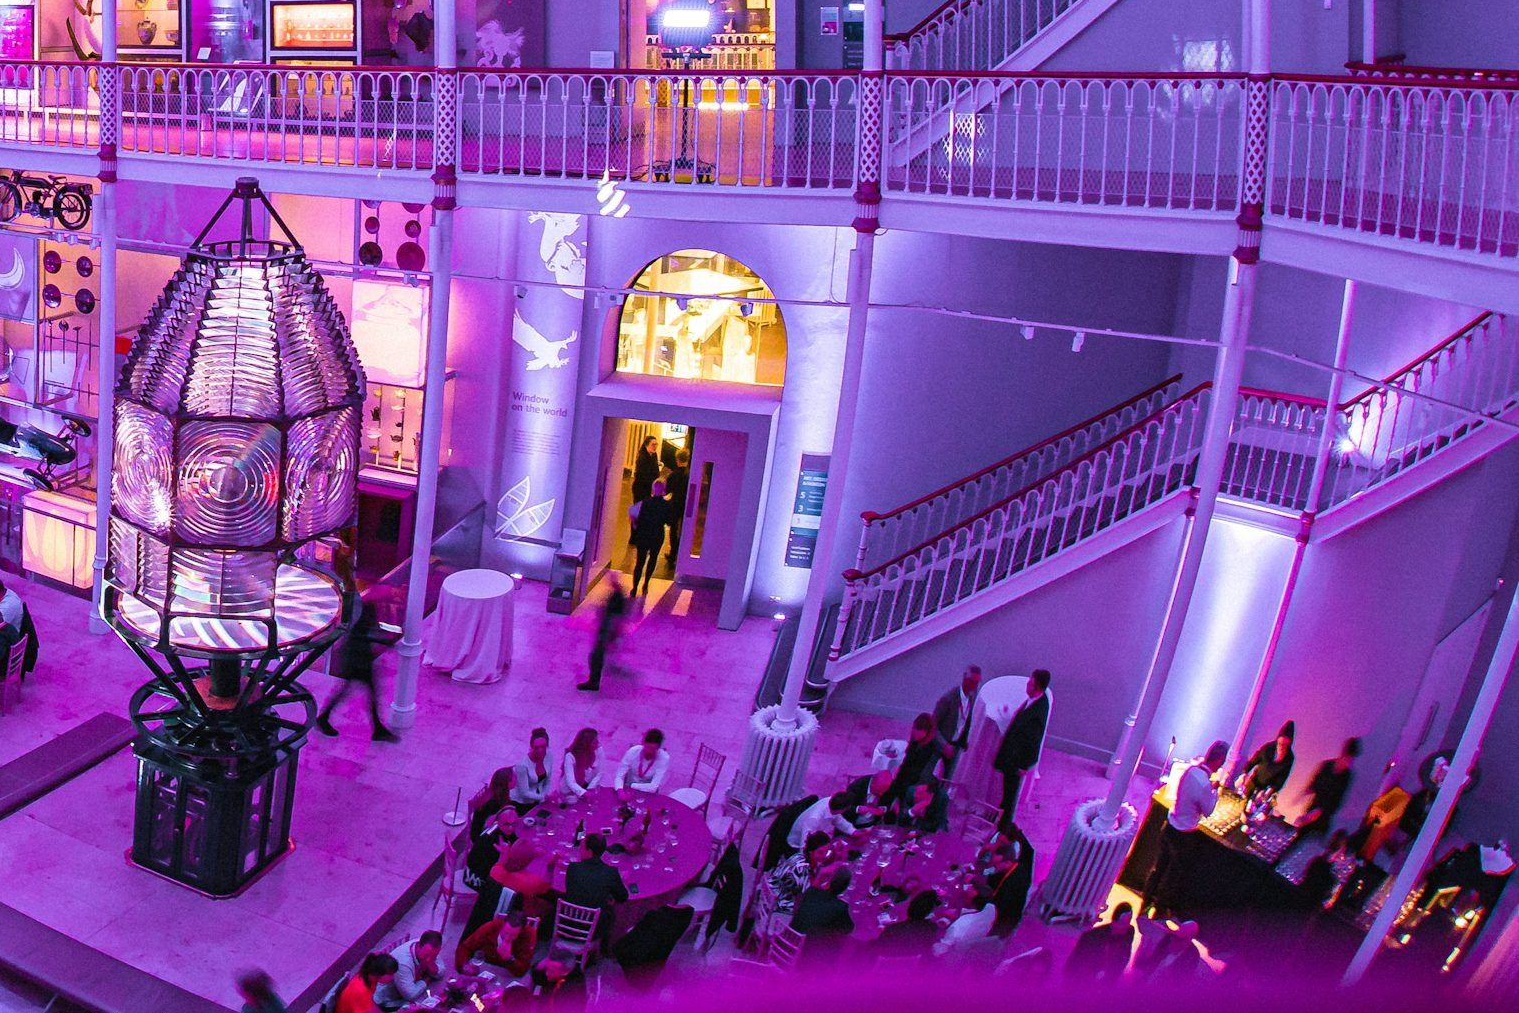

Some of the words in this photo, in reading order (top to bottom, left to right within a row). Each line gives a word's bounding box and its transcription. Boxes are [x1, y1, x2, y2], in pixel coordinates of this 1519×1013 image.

[512, 391, 550, 404] Window
[511, 404, 523, 412] on
[526, 403, 541, 414] the
[543, 408, 568, 417] world
